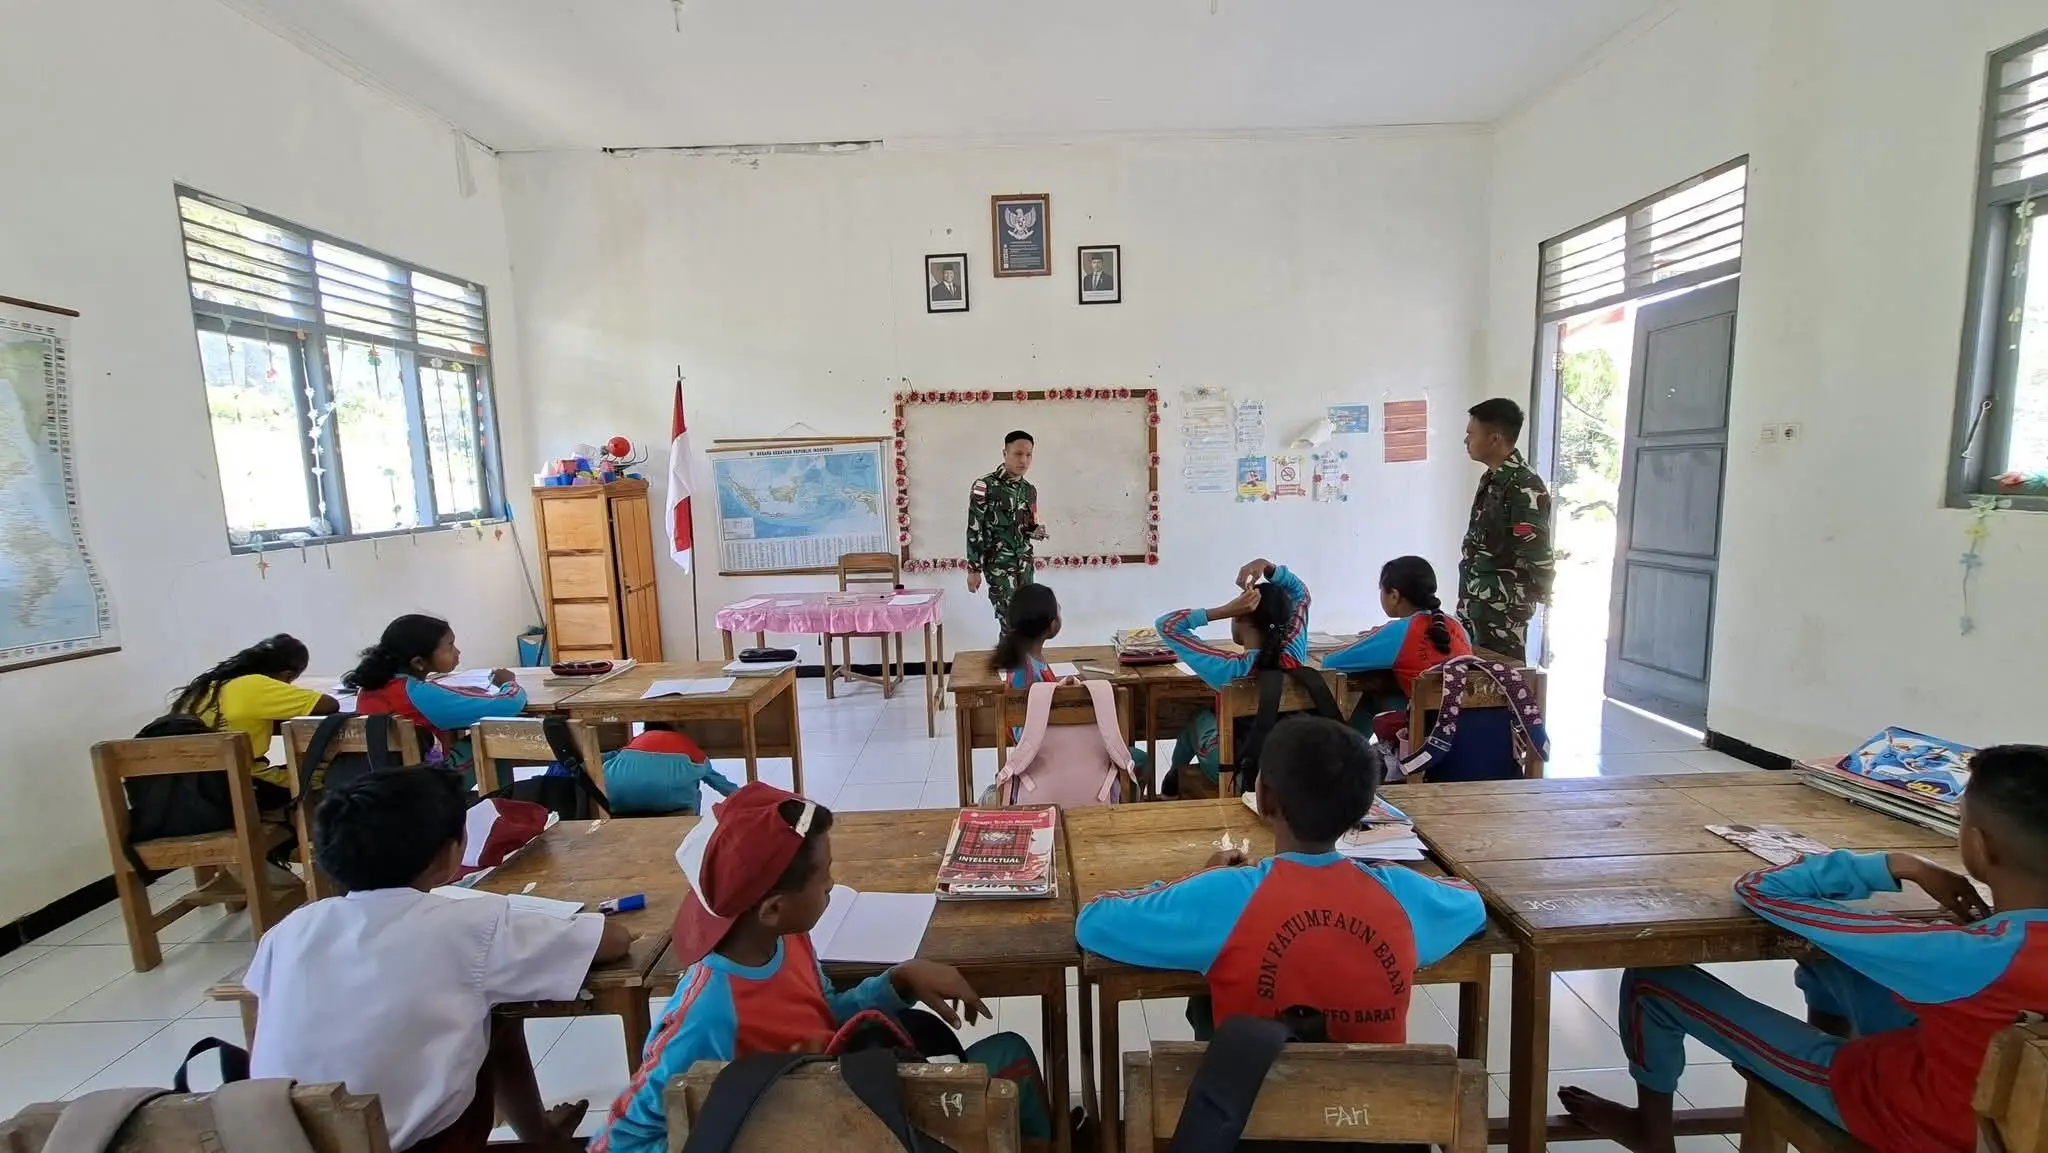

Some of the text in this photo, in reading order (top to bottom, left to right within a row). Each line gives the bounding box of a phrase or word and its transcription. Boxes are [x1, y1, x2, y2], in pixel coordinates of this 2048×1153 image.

[958, 855, 1020, 864] INTELLECTUAL
[1257, 909, 1406, 1000] SDN FATUMFAUN EBAN
[1354, 1007, 1397, 1024] BARAT
